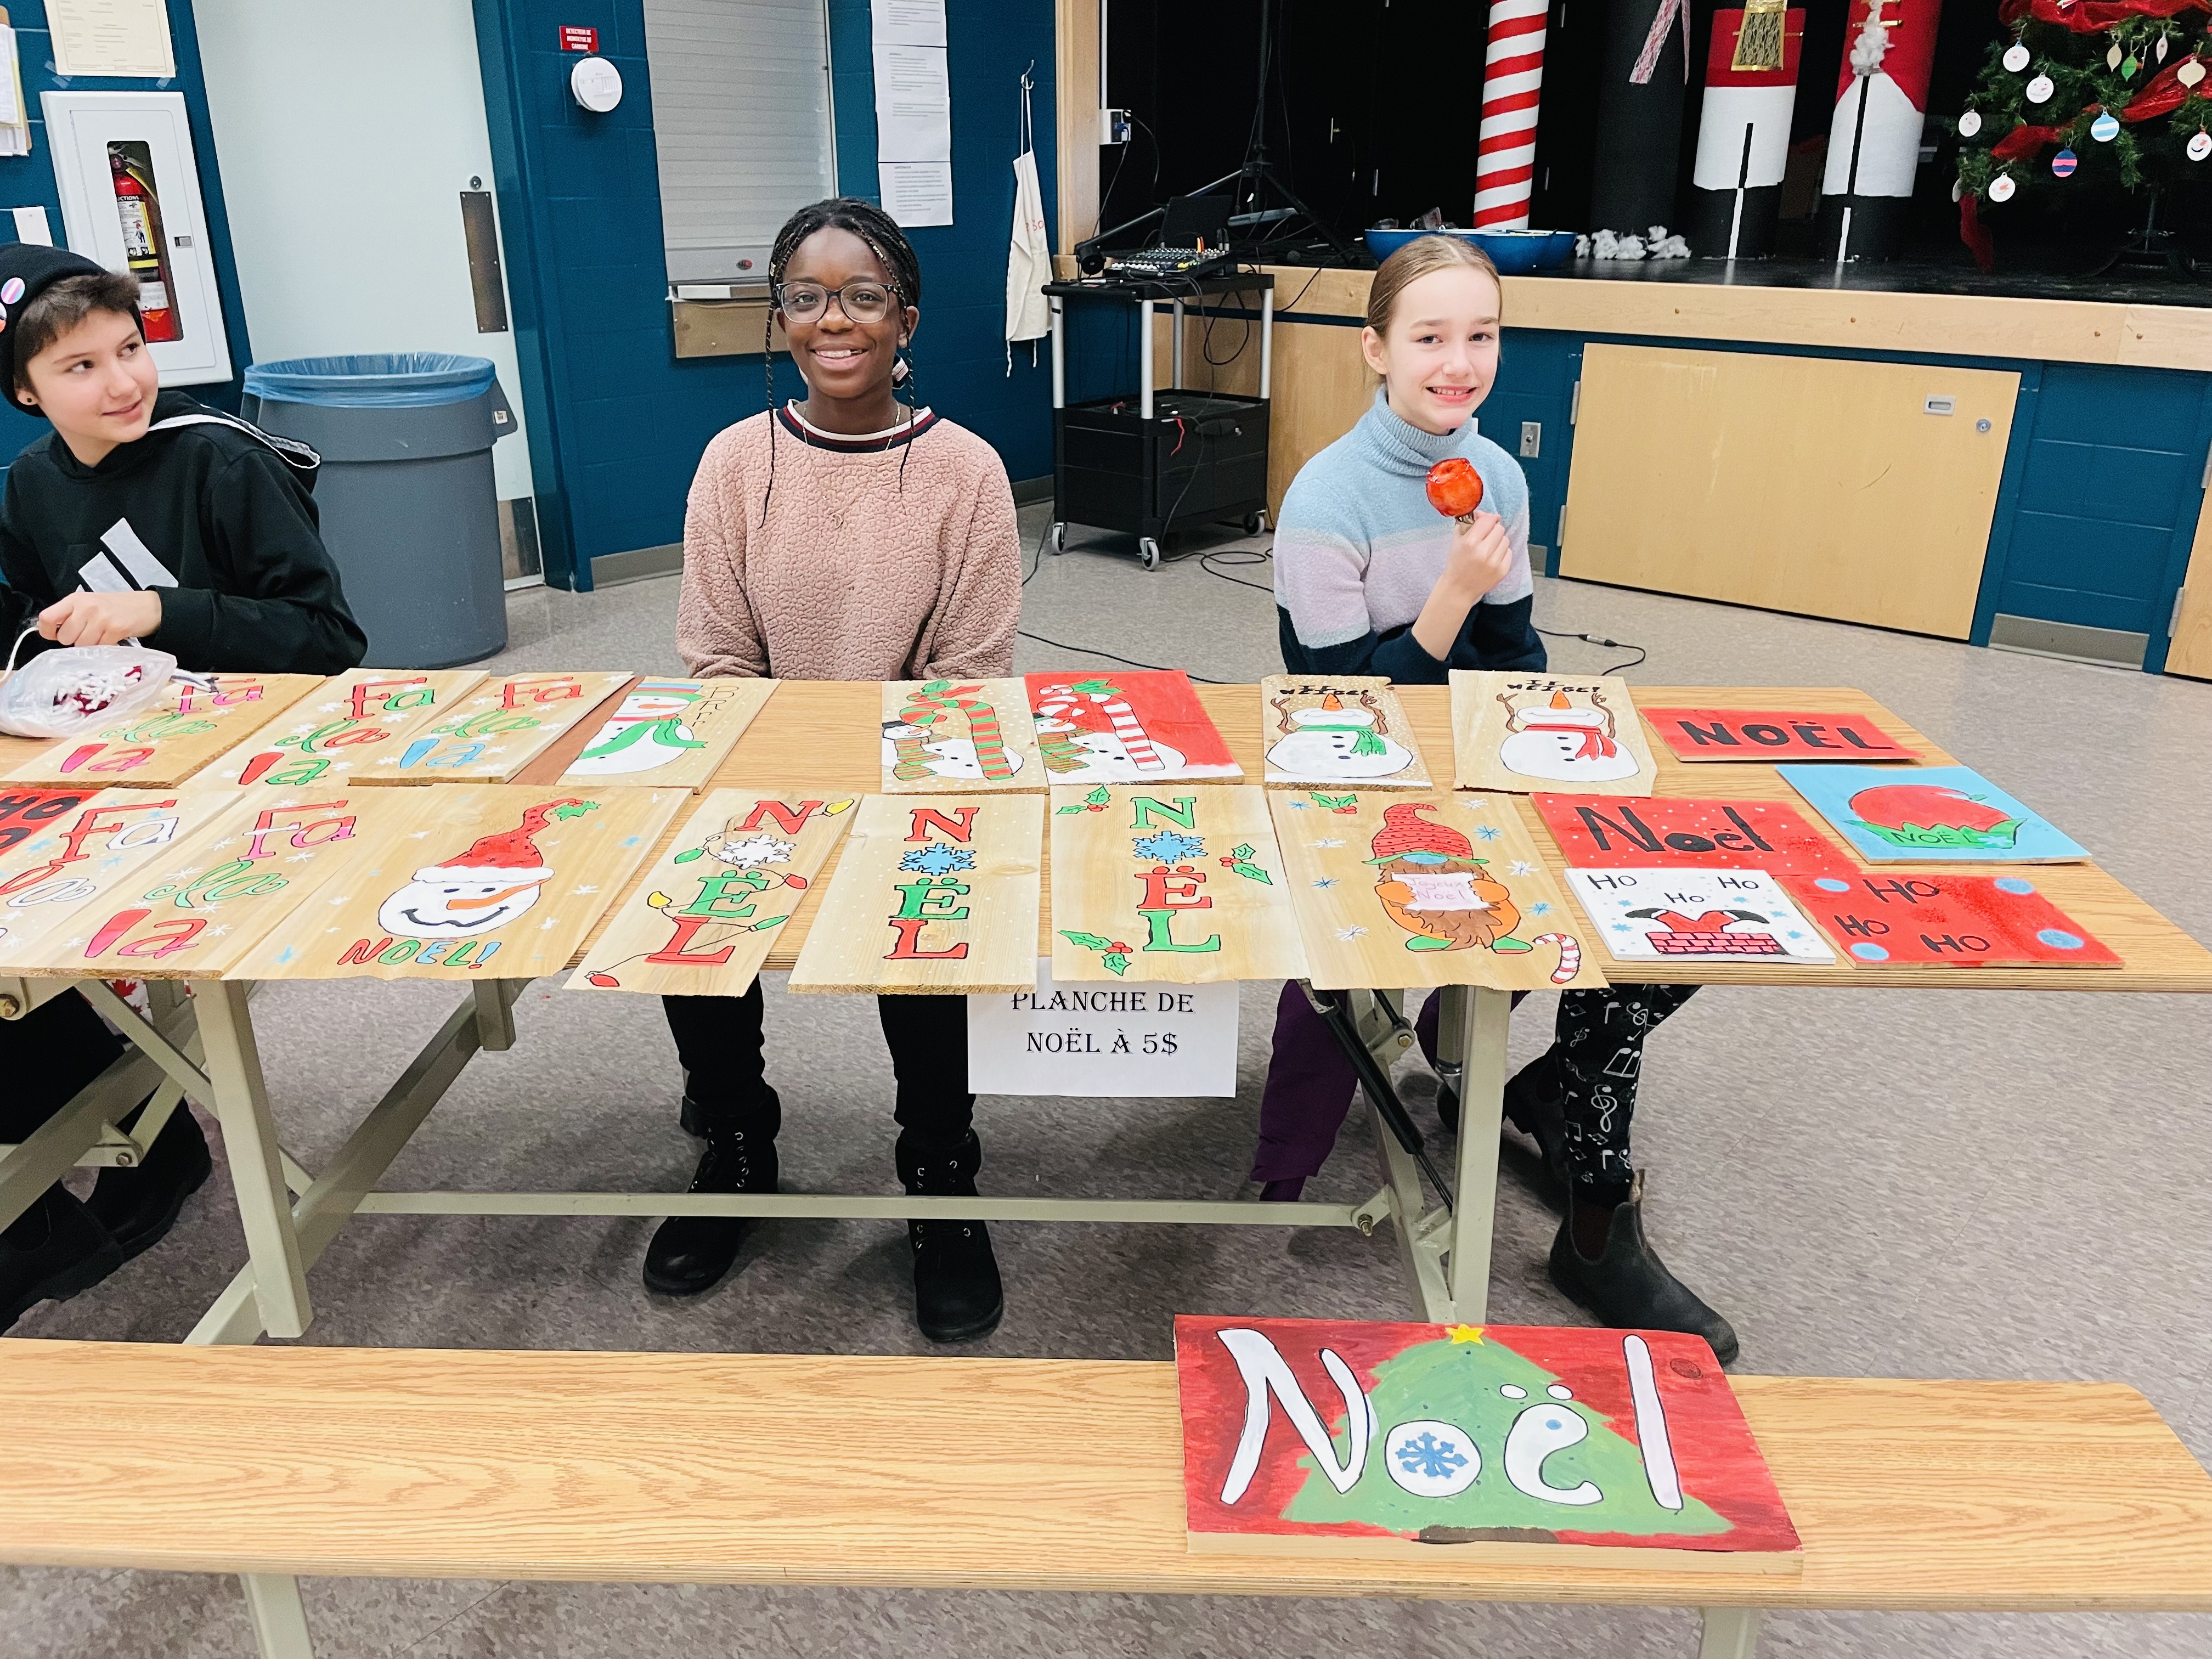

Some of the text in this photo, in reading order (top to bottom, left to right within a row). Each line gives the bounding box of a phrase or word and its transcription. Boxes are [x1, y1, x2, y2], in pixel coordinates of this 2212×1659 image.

[343, 677, 436, 721] Fa
[494, 676, 584, 711] Fa
[1677, 720, 1895, 749] NOËL
[60, 743, 155, 773] la
[238, 752, 331, 786] la
[399, 738, 486, 769] la
[49, 799, 179, 866] Fa
[238, 799, 357, 861] Fa
[1575, 806, 1775, 852] Noël
[1402, 877, 1464, 890] Joyeux
[1417, 889, 1465, 900] Noël
[84, 909, 208, 959] la
[1011, 991, 1195, 1013] PLANCHE DE
[1026, 1028, 1178, 1056] NOËL À 5$
[1216, 1328, 1683, 1511] Noël
